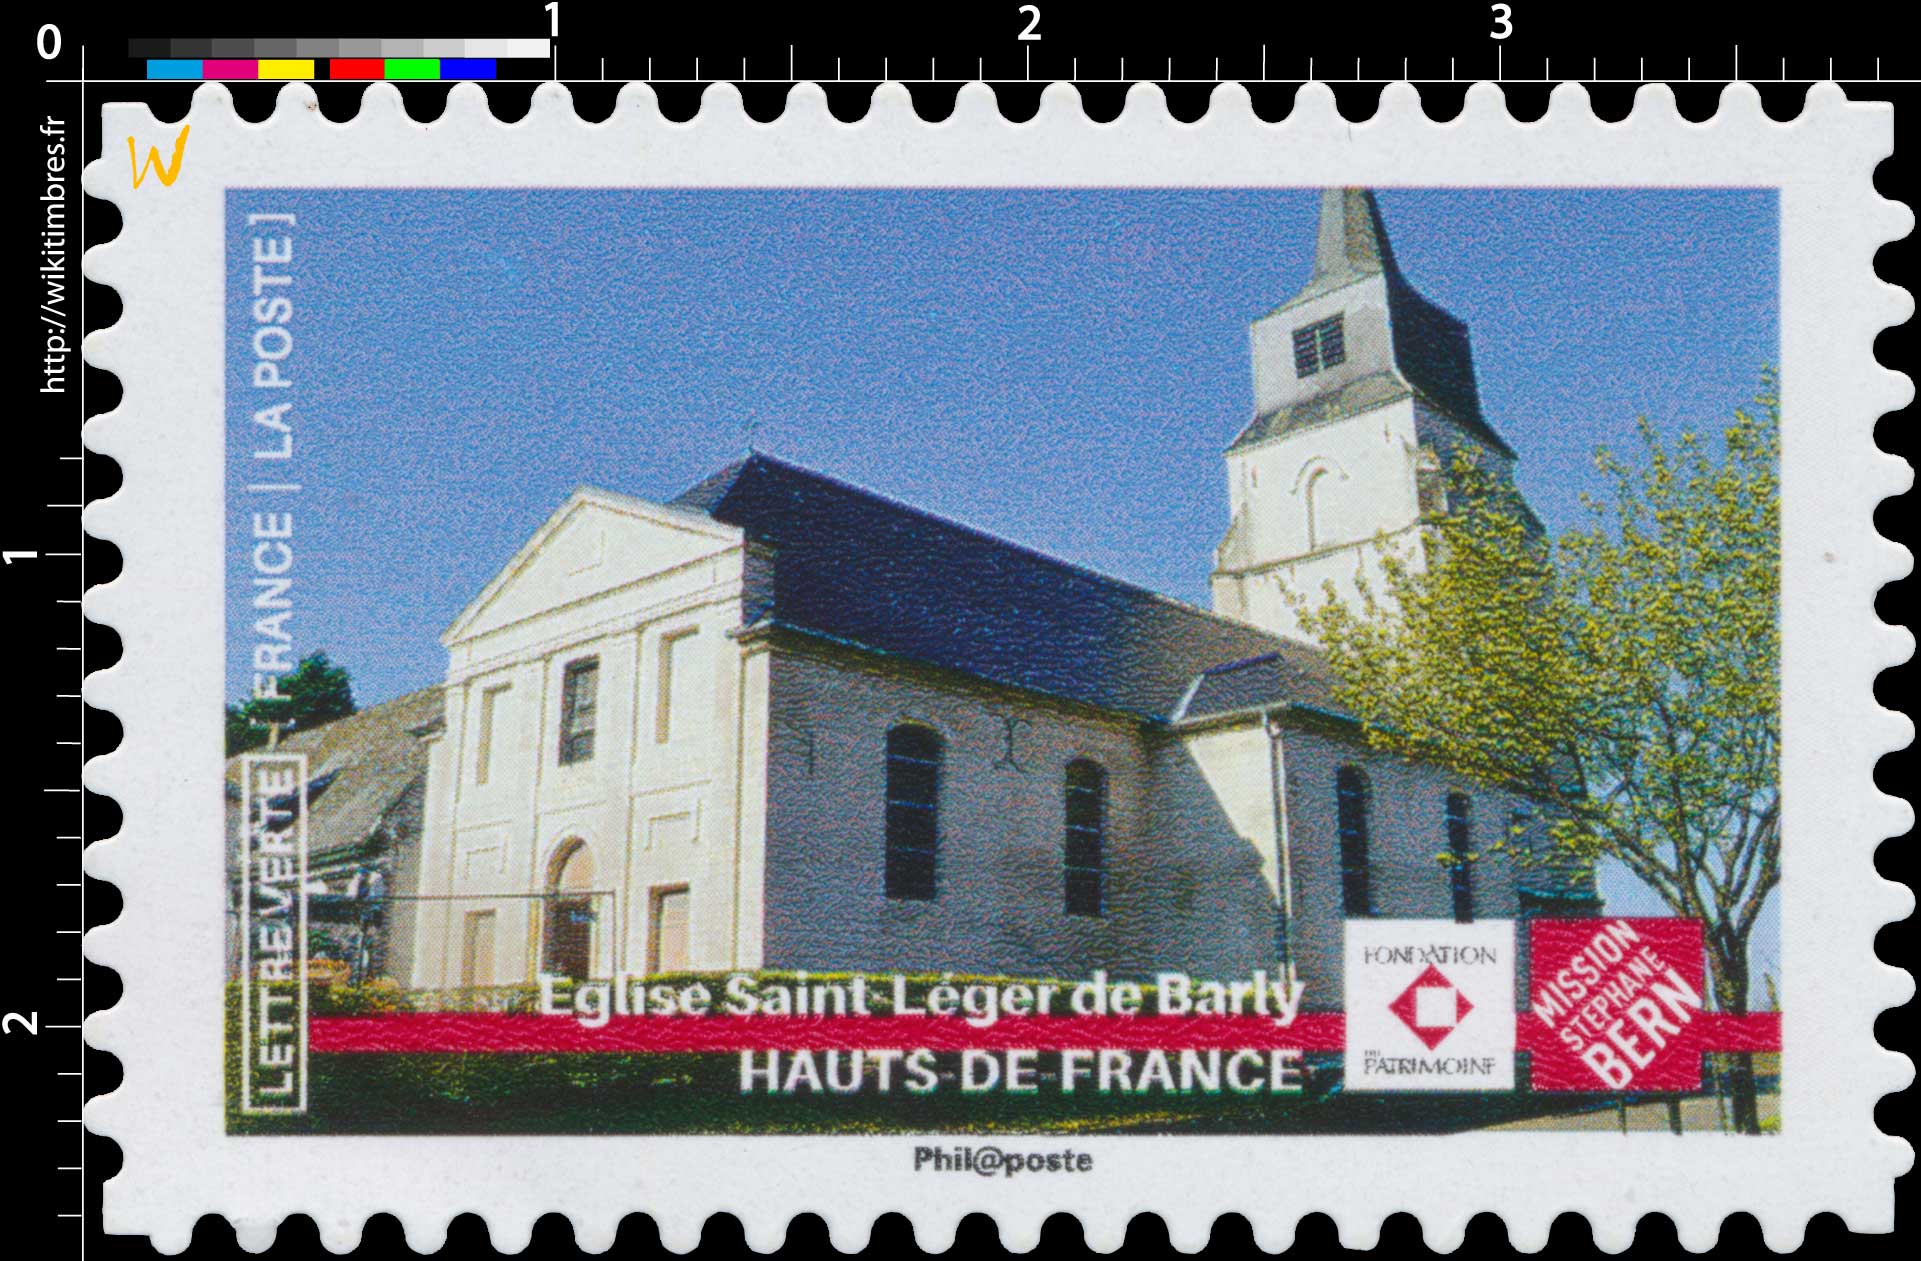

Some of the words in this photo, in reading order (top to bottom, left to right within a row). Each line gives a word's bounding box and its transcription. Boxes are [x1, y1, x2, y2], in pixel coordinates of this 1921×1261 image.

[252, 403, 293, 458] LA
[1071, 970, 1144, 1016] de
[1157, 970, 1305, 1027] Barly
[1533, 919, 1641, 1029] MISSION
[1559, 946, 1665, 1052] STEPHANE
[1581, 968, 1702, 1090] BERN
[914, 1145, 1093, 1178] Phil@poste
